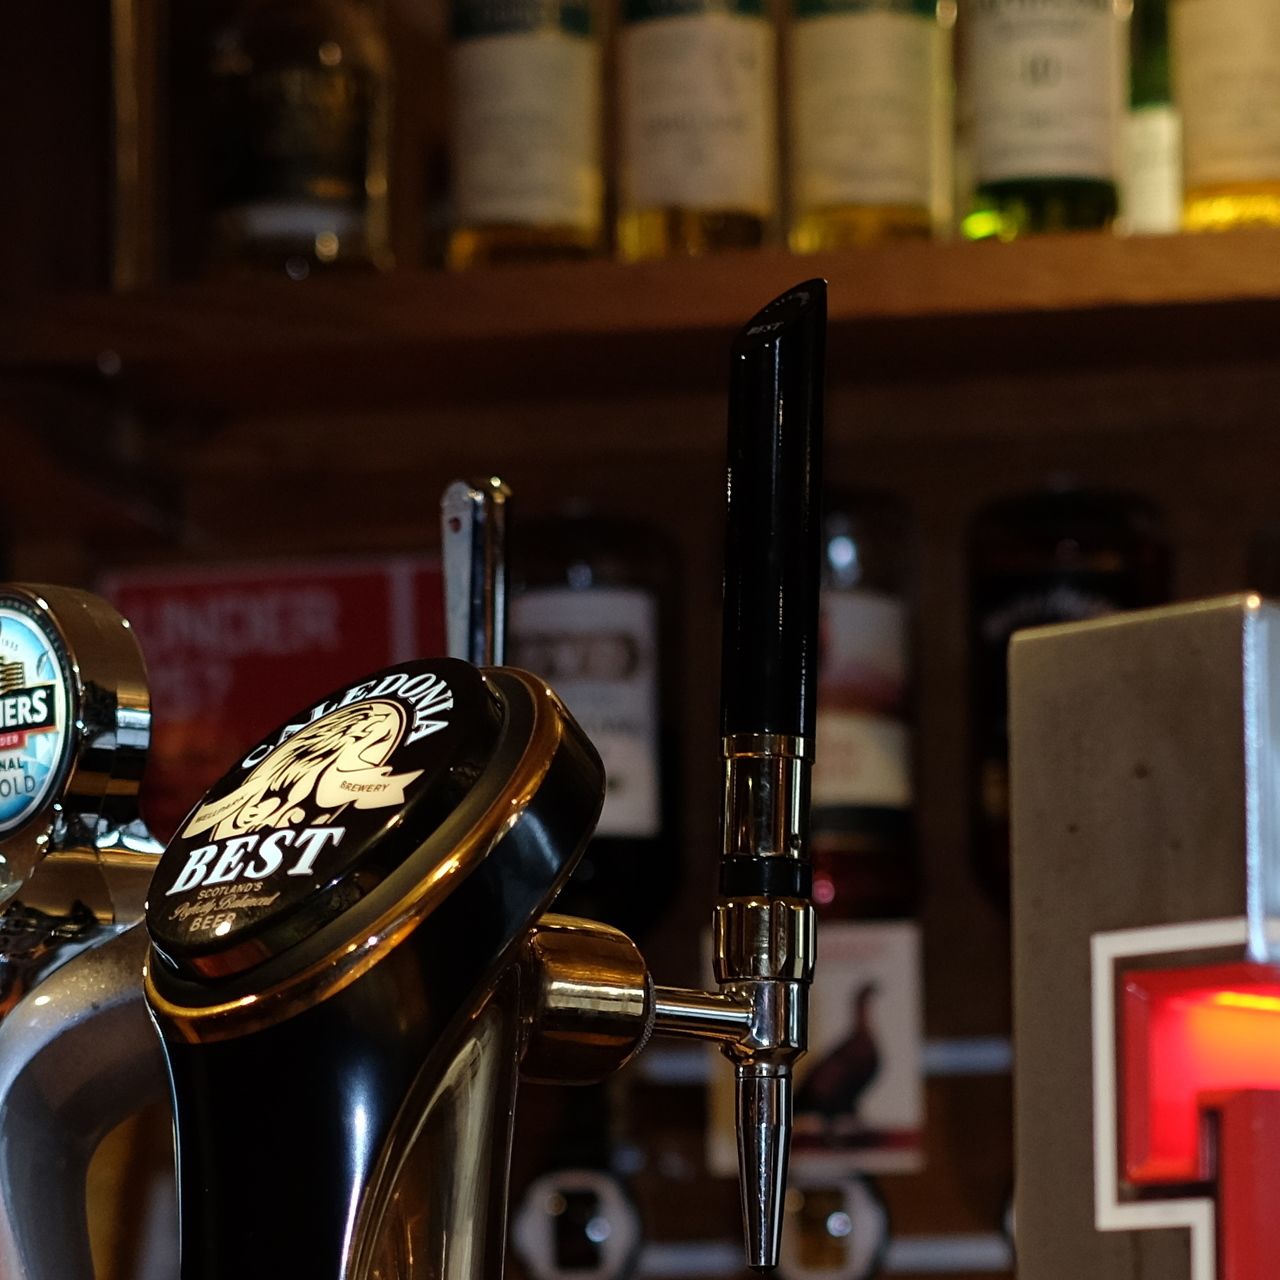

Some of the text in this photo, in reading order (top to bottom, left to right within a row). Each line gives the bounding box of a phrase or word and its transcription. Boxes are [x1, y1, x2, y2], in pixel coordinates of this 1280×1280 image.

[338, 780, 391, 795] BREWERY
[165, 826, 347, 897] BEST
[196, 881, 265, 901] SCOTLAND'S
